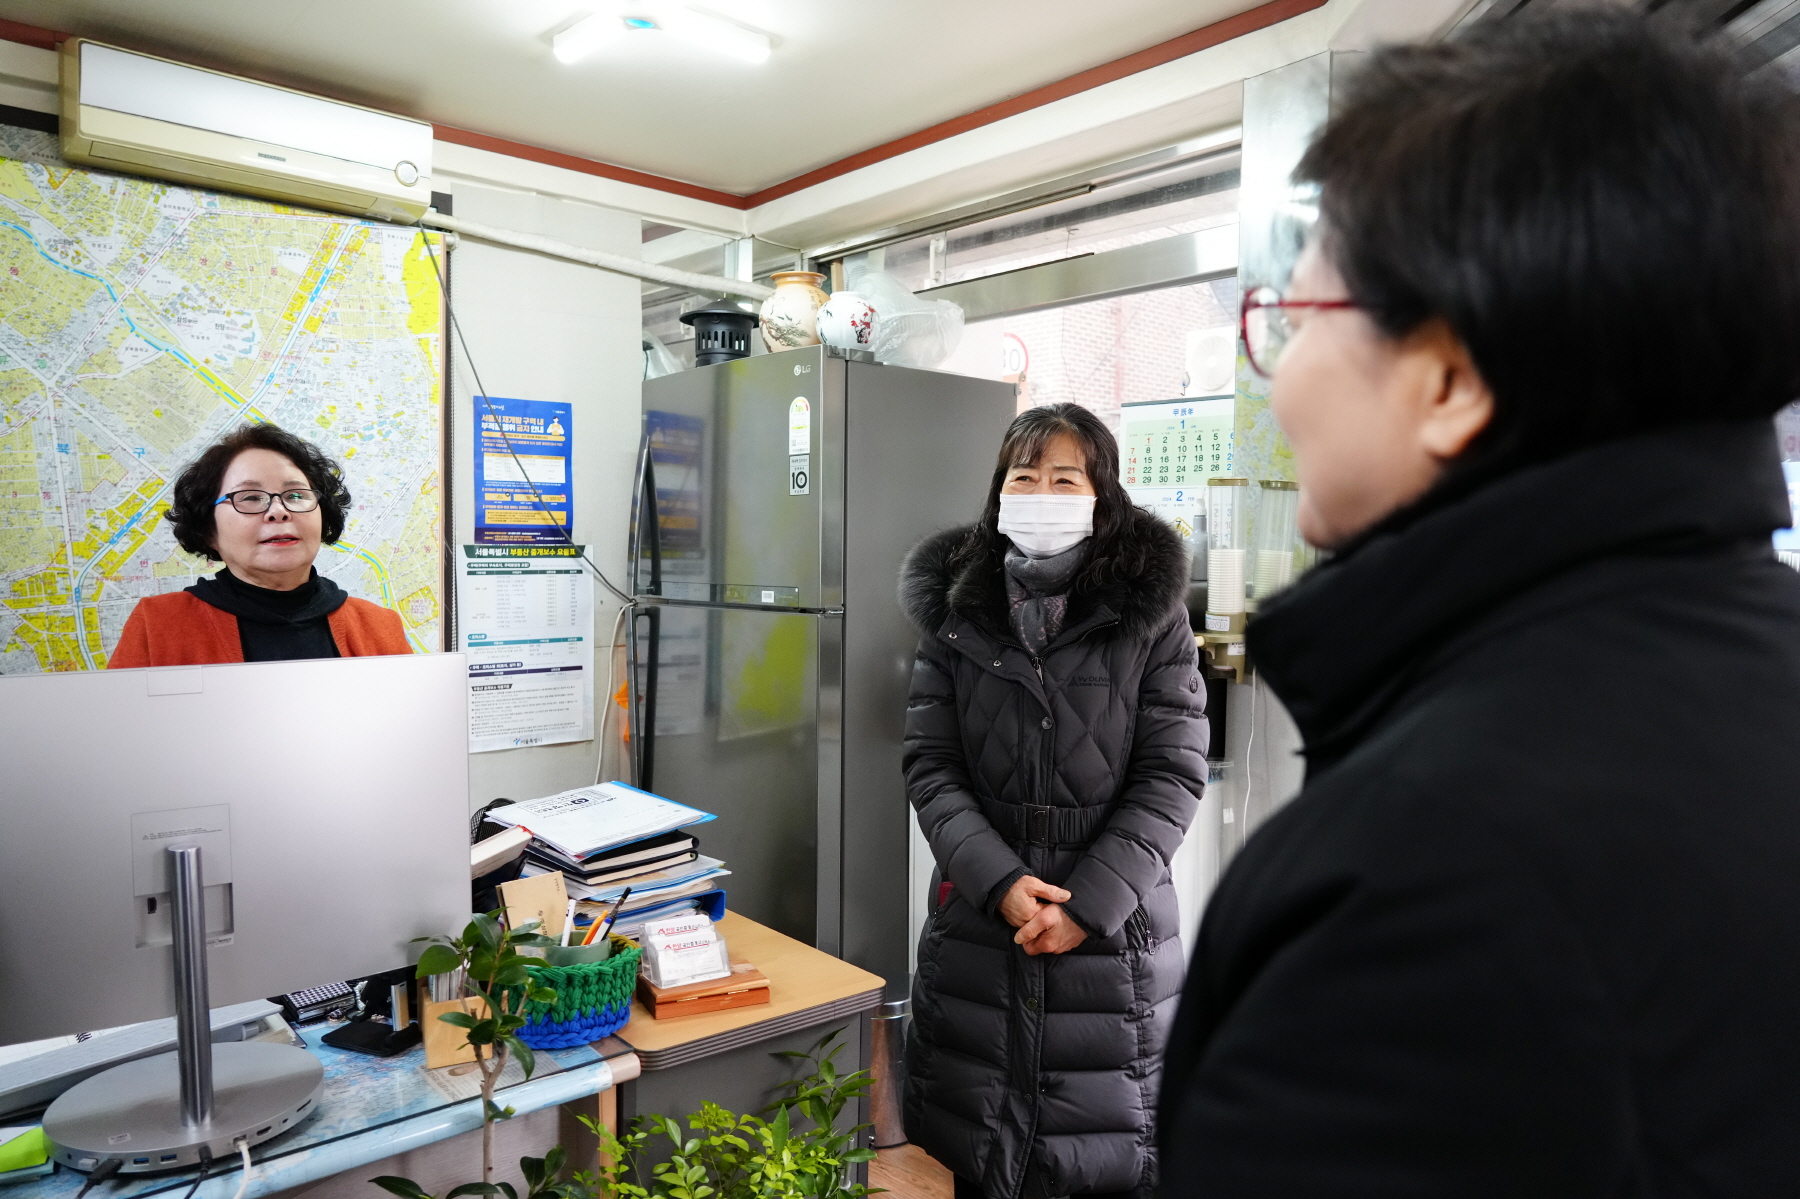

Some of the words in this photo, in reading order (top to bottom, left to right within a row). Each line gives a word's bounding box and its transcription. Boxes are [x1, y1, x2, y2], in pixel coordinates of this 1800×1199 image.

[802, 364, 811, 374] LG
[1173, 408, 1194, 416] 甲辰年
[502, 416, 522, 424] 재개발
[523, 417, 536, 425] 구역
[537, 418, 544, 426] 내
[1180, 419, 1186, 430] 1
[516, 424, 530, 432] 금지
[530, 426, 544, 434] 안내
[56, 442, 70, 455] 북
[133, 447, 146, 458] 구
[792, 470, 808, 490] 10
[1176, 490, 1183, 502] 2
[474, 547, 508, 557] 서울특별시
[510, 548, 530, 556] 부동산
[530, 548, 556, 556] 중개보수
